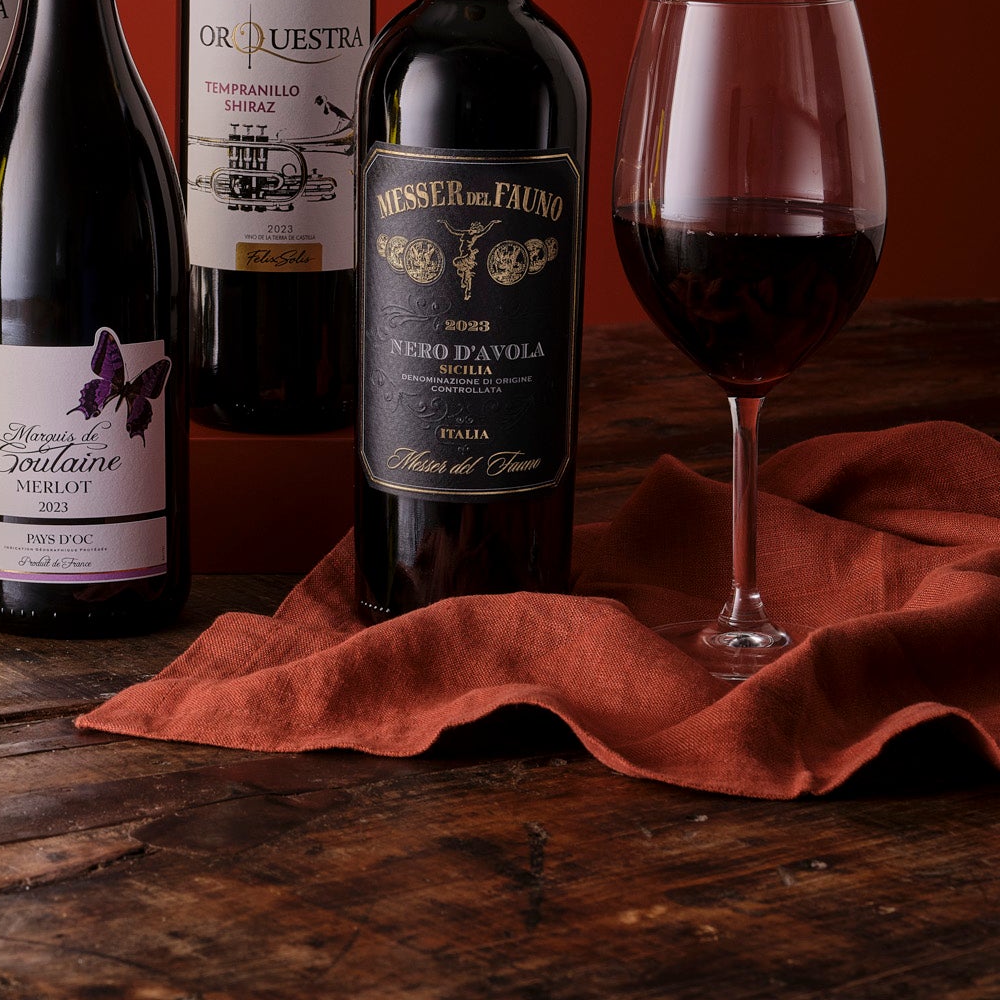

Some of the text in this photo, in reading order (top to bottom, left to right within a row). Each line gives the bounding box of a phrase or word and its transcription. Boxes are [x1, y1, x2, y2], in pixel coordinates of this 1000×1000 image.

[200, 21, 364, 64] ORQUESTRA
[205, 81, 300, 97] TEMPRANILLO
[224, 99, 276, 113] SHIRAZ
[376, 180, 563, 222] MESSER DEL FAUNO
[268, 224, 293, 233] 2023
[444, 319, 490, 332] 2023
[389, 338, 448, 360] NERO
[439, 364, 493, 375] SICILIA
[401, 373, 480, 385] DENOMINAZIONE
[496, 376, 532, 384] ORIGINE
[431, 385, 502, 394] CONTROLLATA
[3, 421, 111, 451] Marquis de
[440, 428, 489, 440] ITALIA
[386, 447, 543, 477] Messer del Fauno
[16, 479, 92, 495] MERLOT
[38, 501, 68, 513] 2023
[27, 533, 93, 545] PAYS D'OC
[18, 555, 92, 569] Produit de France
